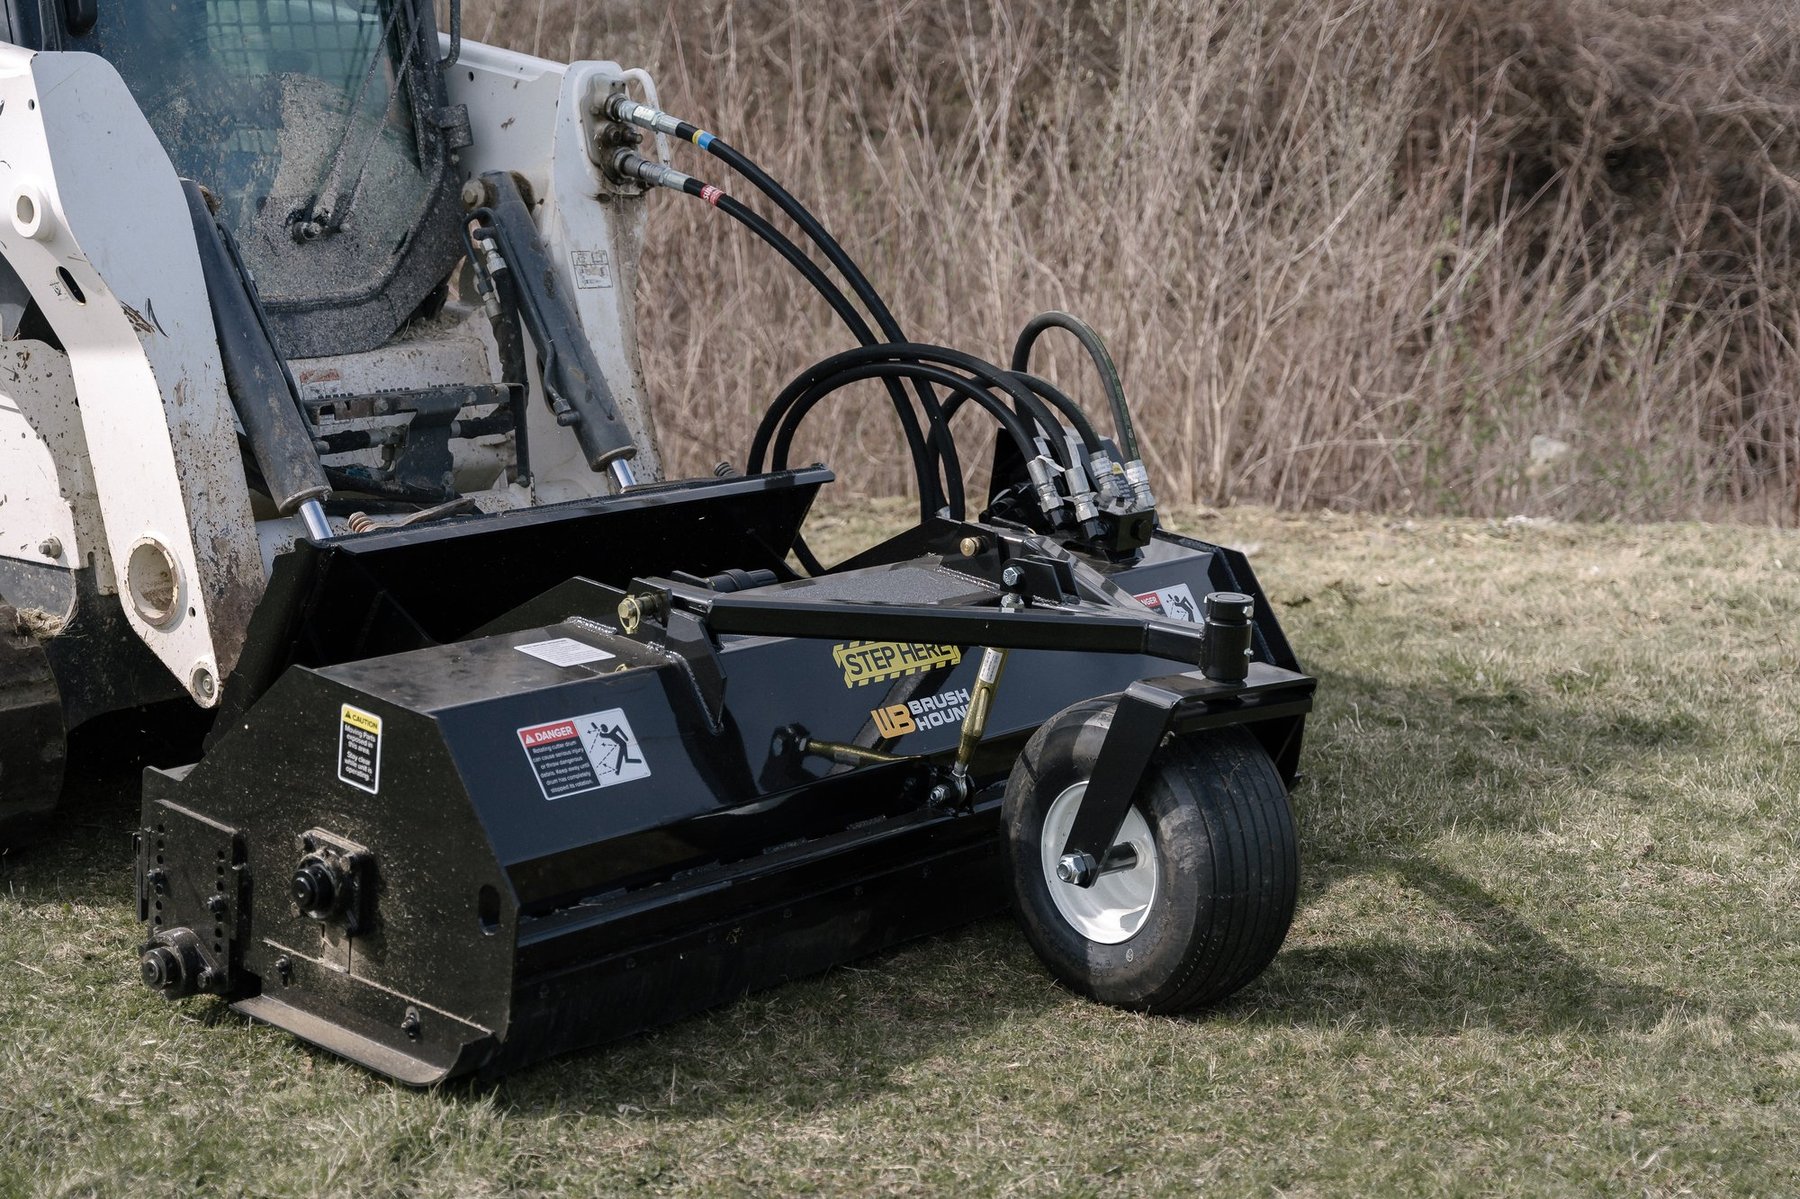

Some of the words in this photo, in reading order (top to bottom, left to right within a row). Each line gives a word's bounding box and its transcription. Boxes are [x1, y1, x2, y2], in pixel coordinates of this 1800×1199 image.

[845, 646, 896, 675] STEP
[907, 688, 971, 715] BRUSH
[352, 714, 378, 730] CAUTION
[914, 705, 969, 732] HOUN
[344, 724, 362, 738] Moving
[363, 731, 376, 743] Parts
[346, 733, 367, 747] exposed
[368, 741, 374, 749] in
[534, 726, 574, 742] DANGER
[347, 740, 357, 750] this
[533, 745, 552, 753] Rotating
[572, 747, 584, 755] injury
[344, 758, 357, 768] while
[358, 762, 368, 772] unit
[367, 766, 373, 774] is
[347, 750, 358, 762] Stay
[358, 756, 371, 766] clear
[559, 756, 583, 765] dangerous
[546, 778, 558, 786] drum
[567, 771, 591, 781] completely
[551, 785, 569, 793] stopped
